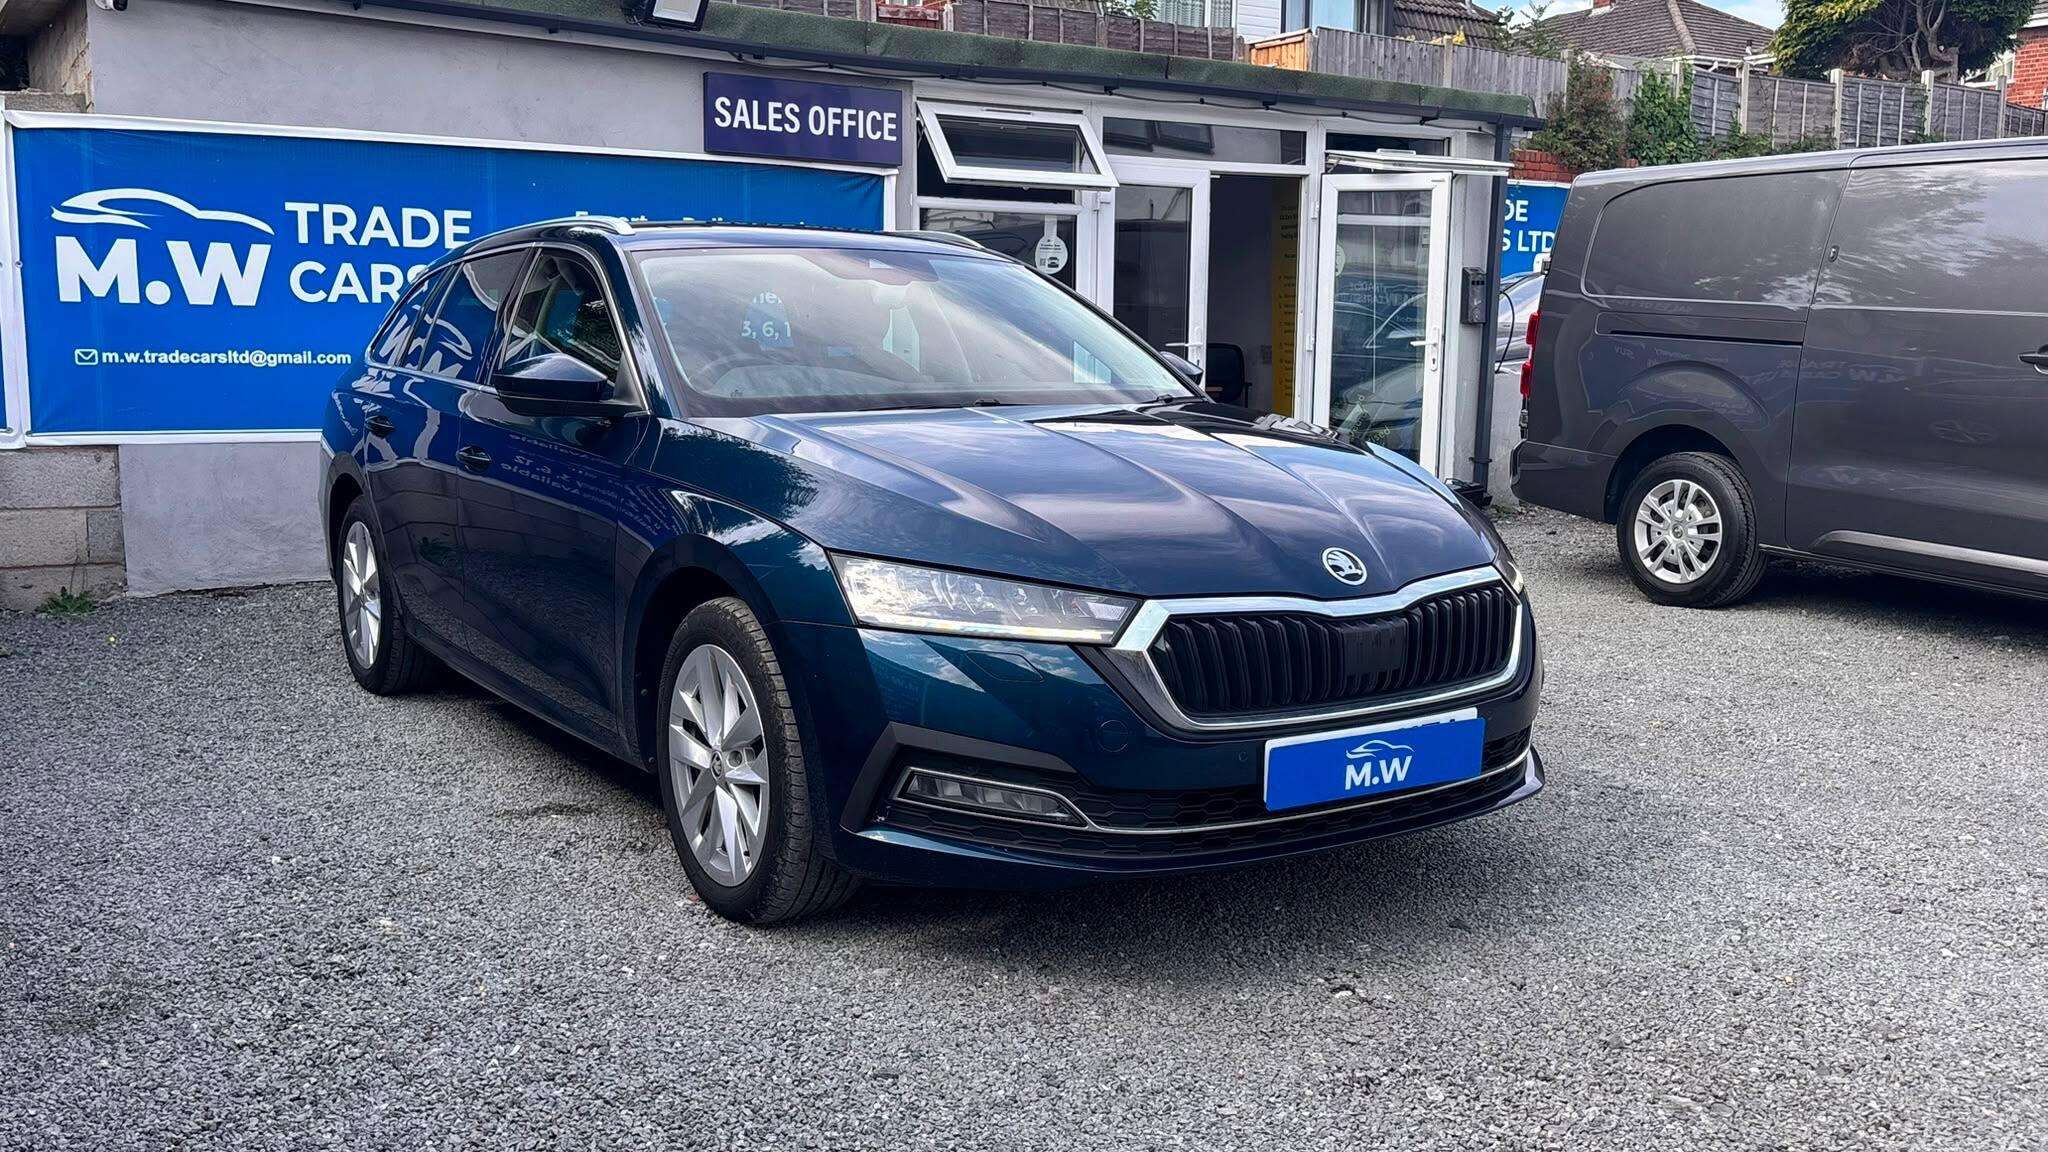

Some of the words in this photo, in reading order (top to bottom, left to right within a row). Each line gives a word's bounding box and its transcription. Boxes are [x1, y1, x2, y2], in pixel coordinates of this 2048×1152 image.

[714, 96, 801, 134] SALES
[808, 105, 897, 142] OFFICE
[284, 201, 472, 249] TRADE
[1517, 229, 1556, 253] LTD
[55, 235, 272, 307] M.W
[101, 349, 352, 368] m.w.tradecarsltd@gmail.com
[1344, 755, 1413, 791] M.W
